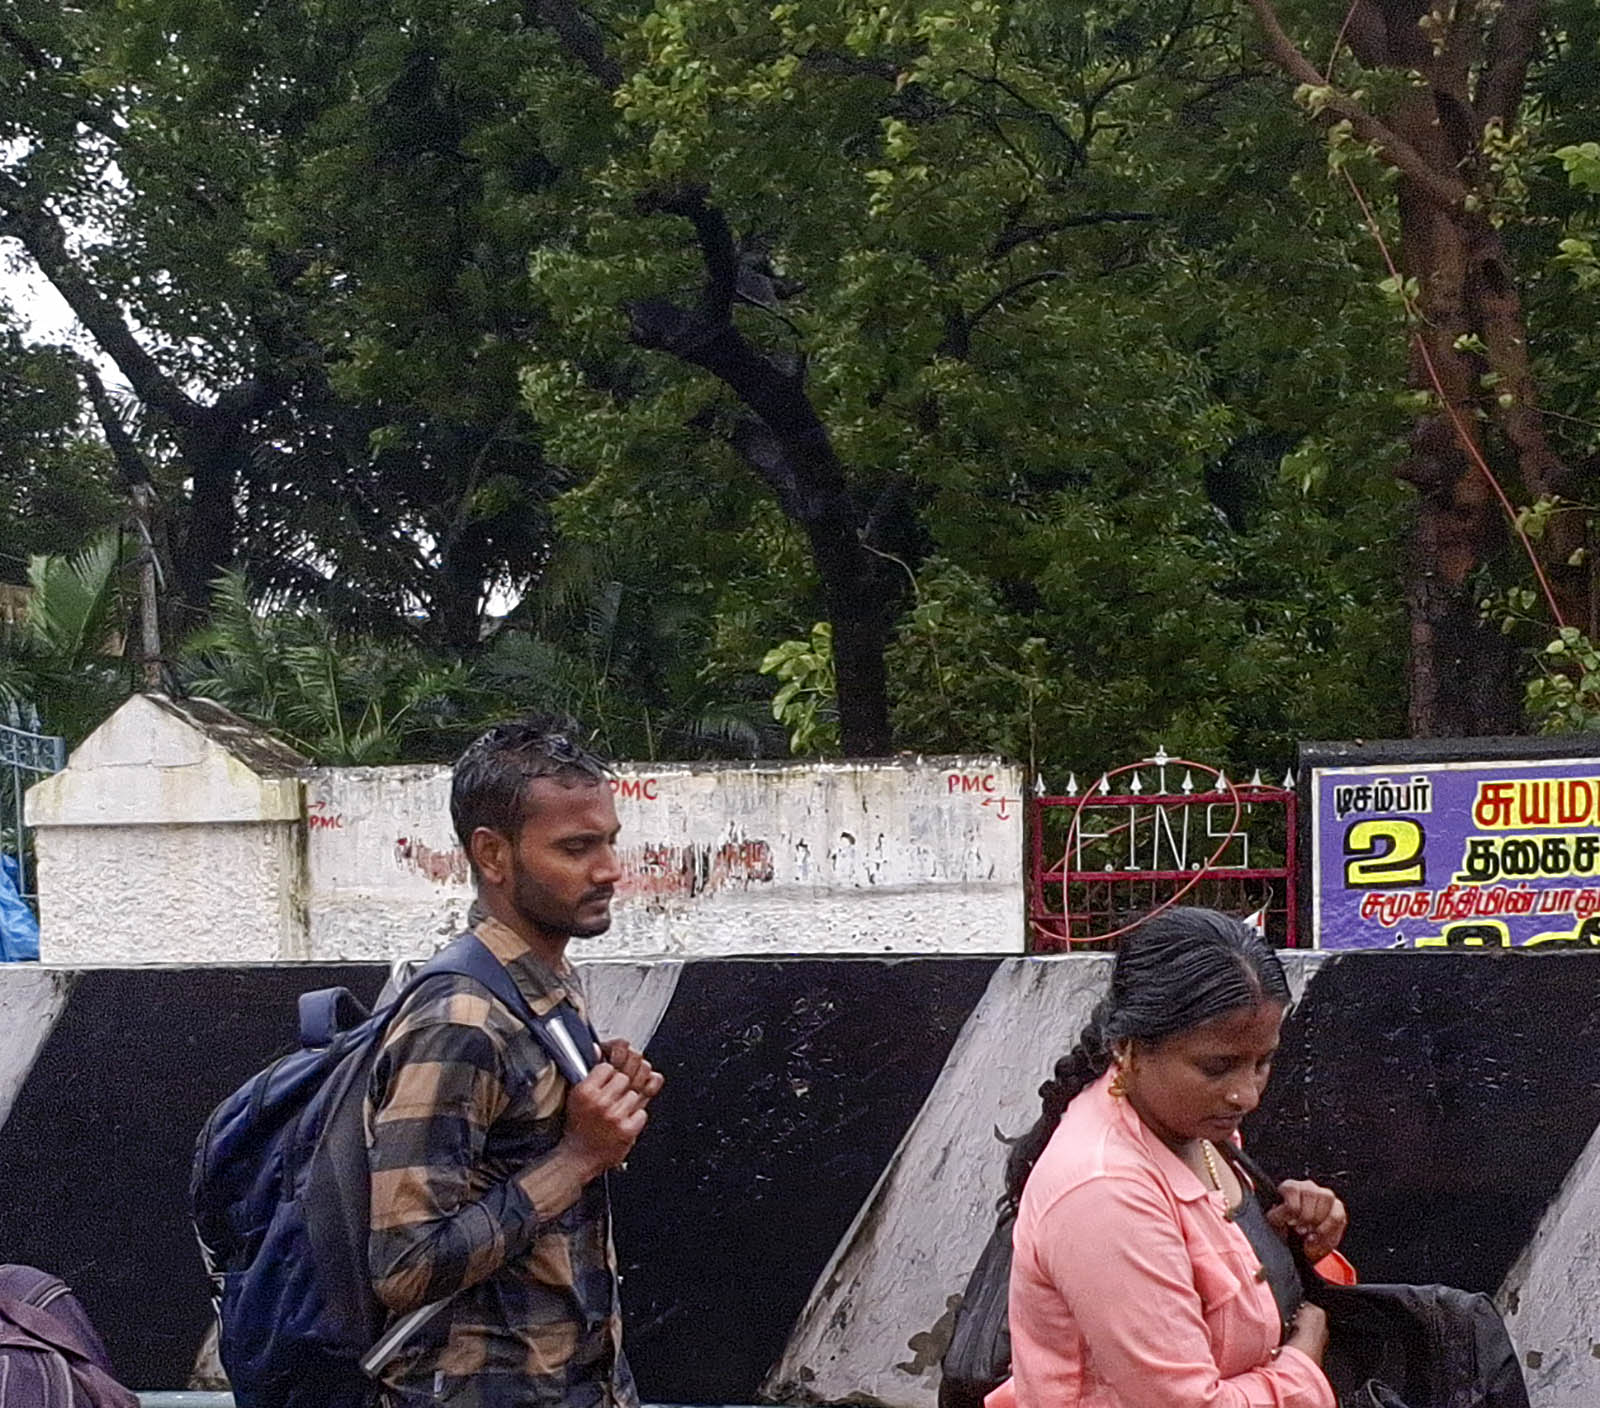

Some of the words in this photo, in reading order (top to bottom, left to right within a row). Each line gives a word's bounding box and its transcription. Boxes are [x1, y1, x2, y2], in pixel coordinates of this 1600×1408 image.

[607, 779, 657, 801] PMC
[949, 774, 995, 794] PMC
[1335, 777, 1431, 818] டிசம்பர்
[309, 813, 343, 829] PMC
[1343, 817, 1426, 890] 2
[1360, 891, 1432, 926] சமூக
